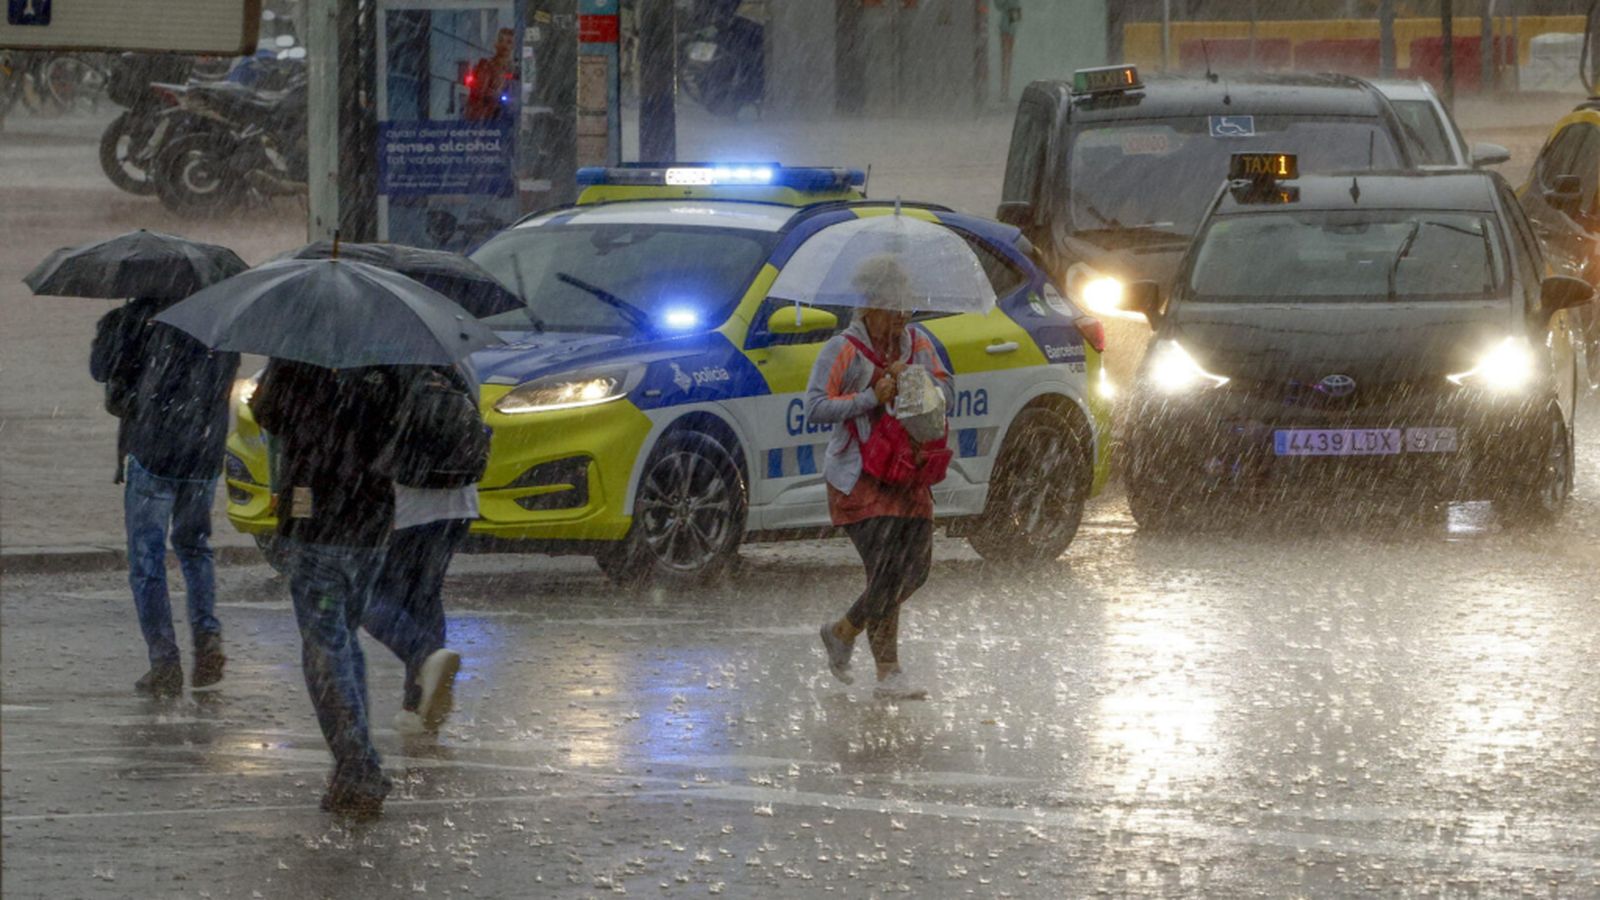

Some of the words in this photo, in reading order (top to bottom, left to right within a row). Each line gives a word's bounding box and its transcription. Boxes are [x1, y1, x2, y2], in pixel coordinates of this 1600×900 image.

[1125, 69, 1133, 85] 1
[386, 143, 435, 153] sense
[439, 139, 501, 151] alcohol
[1242, 156, 1277, 174] TAXI
[1278, 155, 1287, 174] 1
[1289, 432, 1343, 452] 4439
[1351, 432, 1393, 451] LDX
